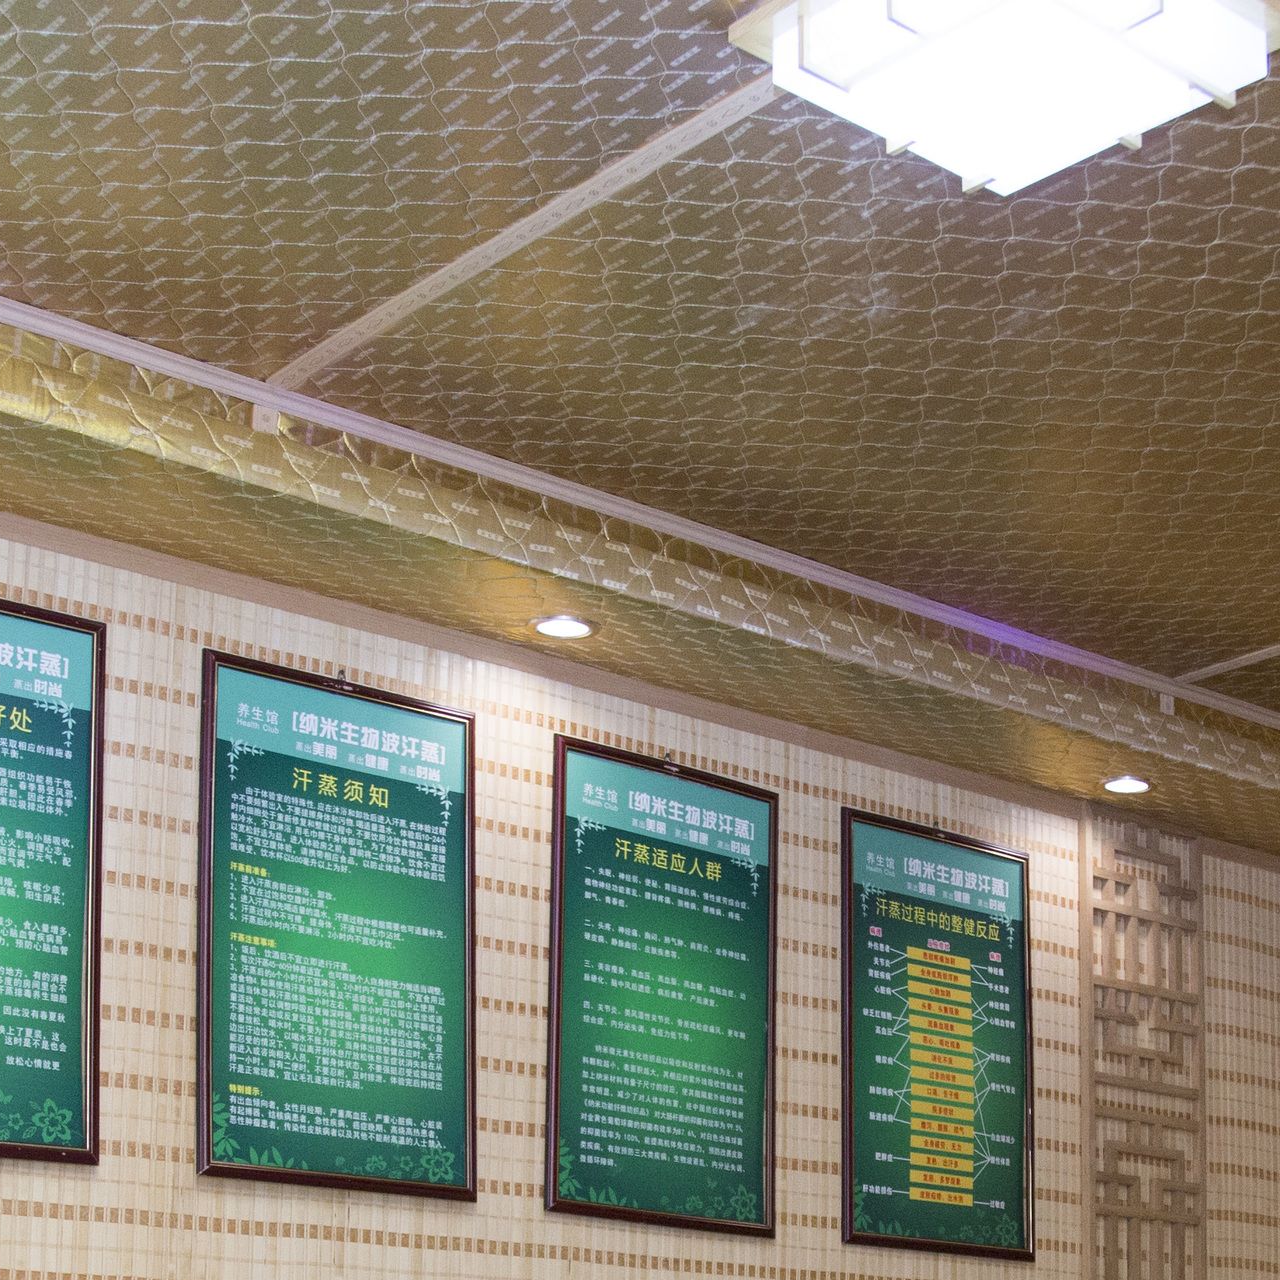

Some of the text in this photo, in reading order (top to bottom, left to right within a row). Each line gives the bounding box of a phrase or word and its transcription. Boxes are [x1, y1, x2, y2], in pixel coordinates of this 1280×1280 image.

[13, 674, 62, 699] 蒸出时尚
[235, 716, 279, 735] Health Club
[237, 702, 279, 725] 养生馆
[292, 766, 389, 809] 汗蒸须知
[583, 781, 617, 804] 养生馆
[614, 836, 722, 883] 汗蒸适应人群
[866, 851, 895, 869] 养生馆
[875, 896, 1000, 942] 汗蒸过程中的整健反应
